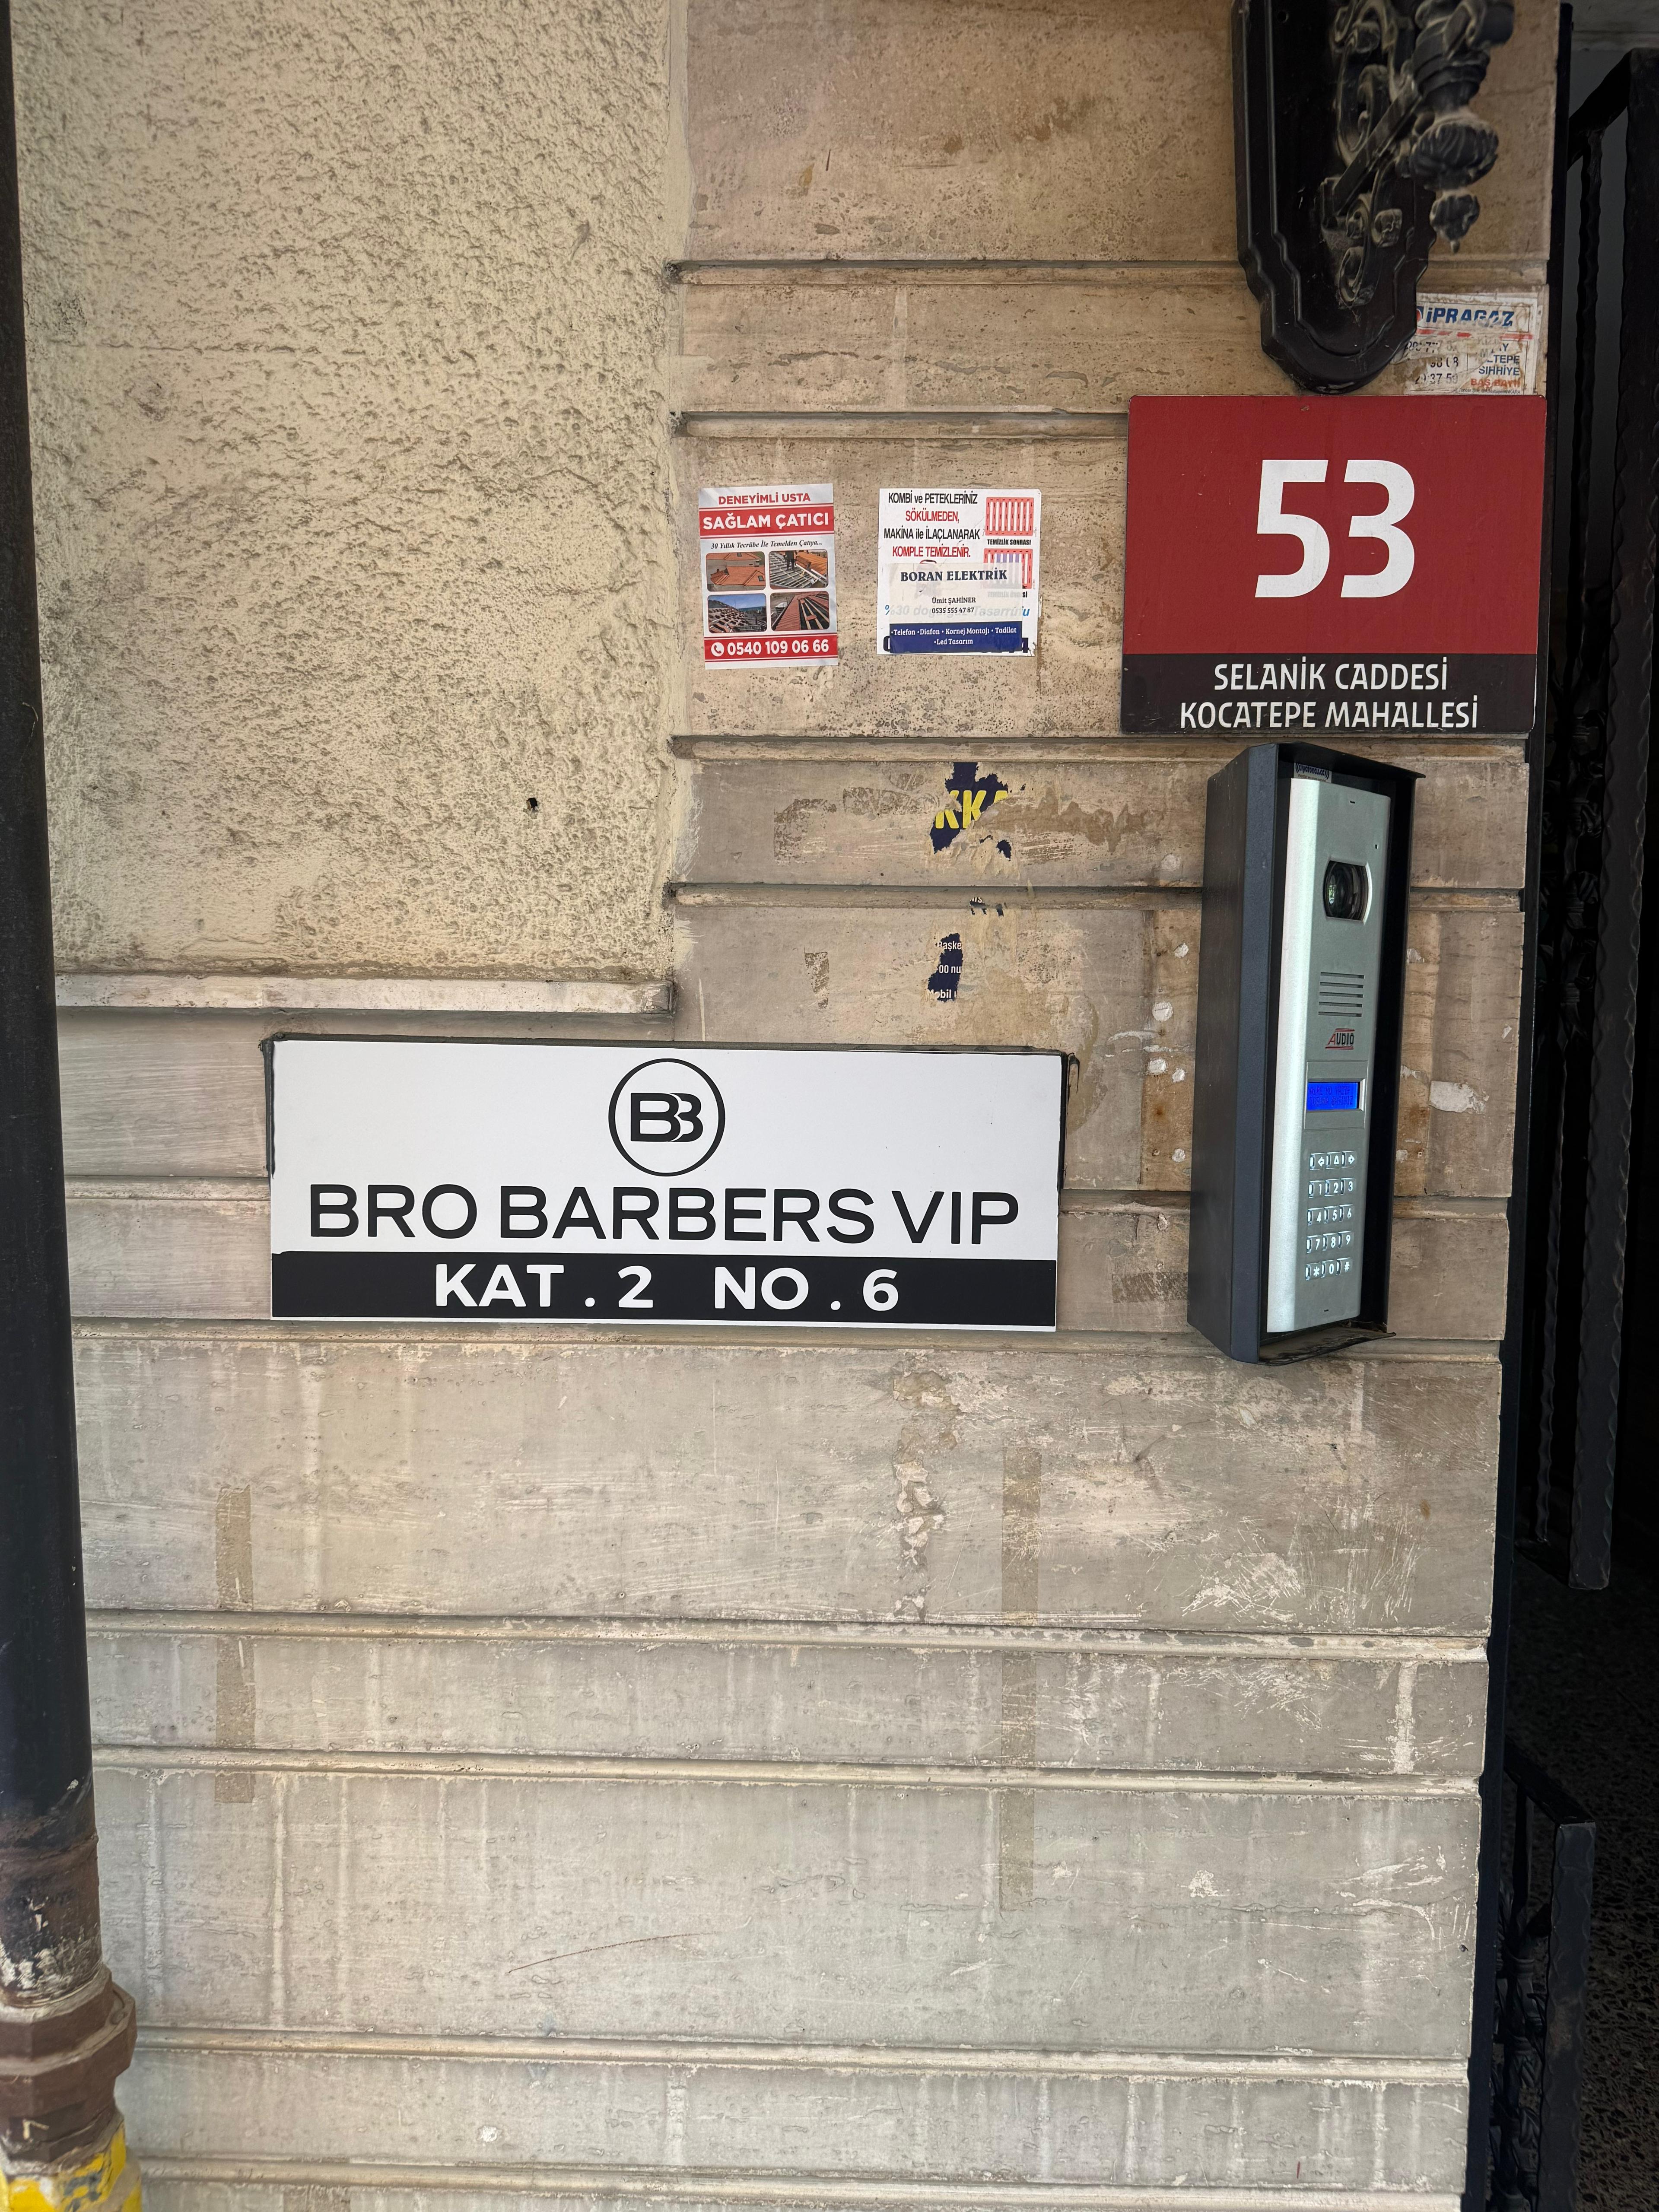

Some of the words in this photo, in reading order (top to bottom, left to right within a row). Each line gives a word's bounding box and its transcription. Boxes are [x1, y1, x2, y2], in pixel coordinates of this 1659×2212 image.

[718, 492, 779, 505] DENEYİMLİ
[782, 493, 811, 502] USTA
[888, 490, 912, 504] KOMBİ
[914, 495, 923, 503] ve
[925, 490, 978, 504] PETEKLERİNİZ
[703, 513, 771, 530] SAĞLAM
[775, 512, 829, 529] ÇATICI
[906, 507, 960, 524] SÖKÜLMEDEN,
[884, 525, 914, 540] MAKİNA
[925, 526, 980, 543] İLAÇLANARAK
[1255, 460, 1415, 597] 53
[893, 546, 923, 557] KOMPLE
[926, 544, 971, 558] TEMİZLENİR.
[900, 571, 943, 582] BORAN
[946, 567, 1007, 581] ELEKTRİK
[948, 595, 976, 605] ŞAHİNER
[727, 641, 762, 656] 0540
[765, 641, 788, 654] 109
[791, 640, 809, 653] 06
[813, 639, 829, 652] 66
[1214, 657, 1325, 691] SELANİK
[1335, 657, 1447, 691] CADDESİ
[1180, 701, 1316, 728] KOCATEPE
[1325, 695, 1478, 729] MAHALLESİ
[1328, 1033, 1354, 1046] AUDIO
[1319, 1184, 1322, 1195] 1
[1334, 1182, 1338, 1193] 2
[1348, 1181, 1353, 1191] 3
[309, 1184, 477, 1239] BRO
[500, 1186, 875, 1244] BARBERS
[891, 1190, 1019, 1245] VIP
[1316, 1211, 1321, 1223] 4
[1332, 1210, 1337, 1221] 5
[1347, 1208, 1351, 1219] 6
[1315, 1239, 1320, 1250] 7
[1331, 1237, 1336, 1248] 8
[1346, 1235, 1351, 1245] 9
[1329, 1264, 1334, 1274] 0
[435, 1263, 564, 1309] KAT
[617, 1265, 653, 1309] 2
[715, 1267, 810, 1310] NO
[863, 1268, 899, 1312] 6
